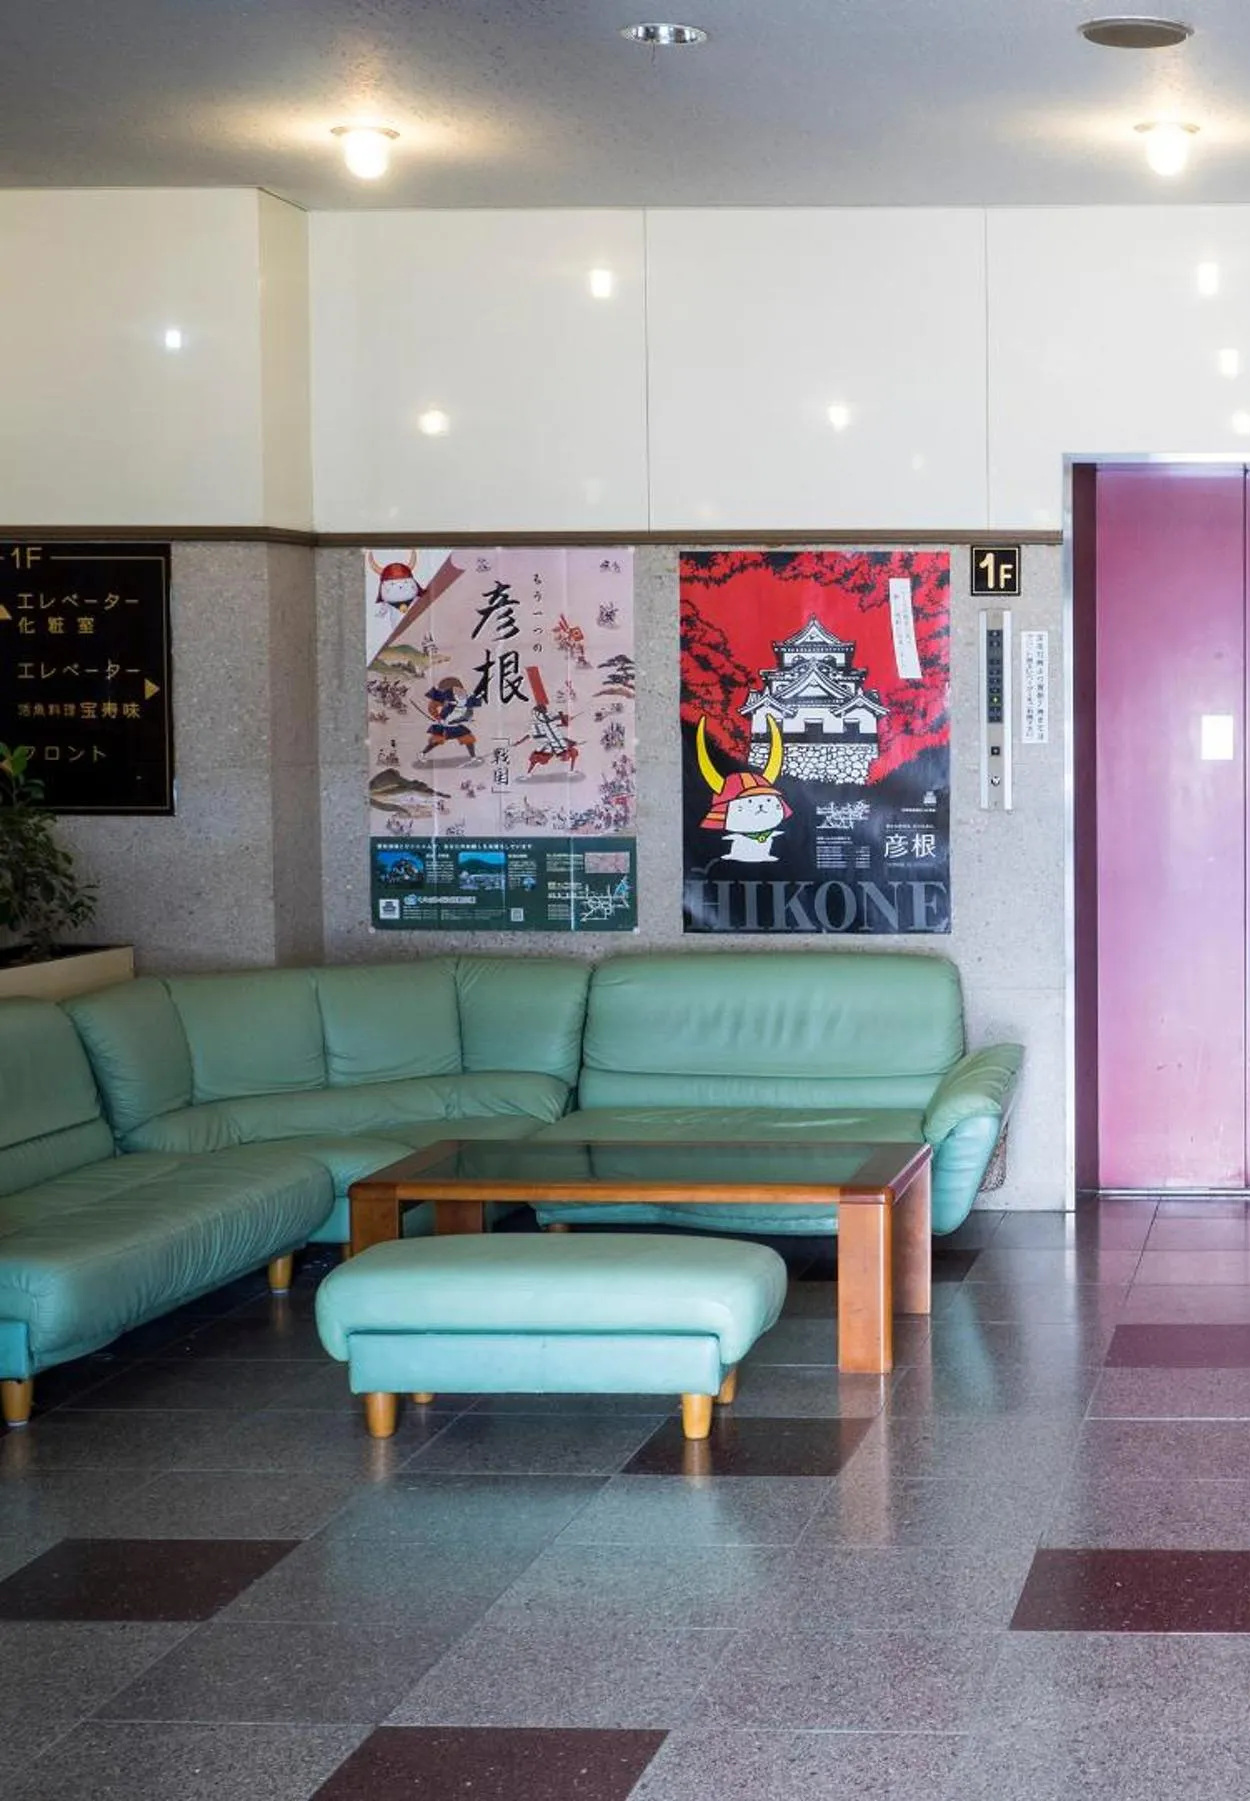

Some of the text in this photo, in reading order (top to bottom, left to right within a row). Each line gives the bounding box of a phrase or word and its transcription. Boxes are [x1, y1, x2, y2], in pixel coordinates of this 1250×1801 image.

[10, 547, 43, 569] 1F
[979, 552, 1013, 589] 1F
[17, 593, 140, 611] エレベーター
[471, 580, 530, 704] 彦根
[17, 662, 141, 680] エレベーター
[884, 833, 937, 859] 彦根
[685, 880, 948, 932] HIKONE
